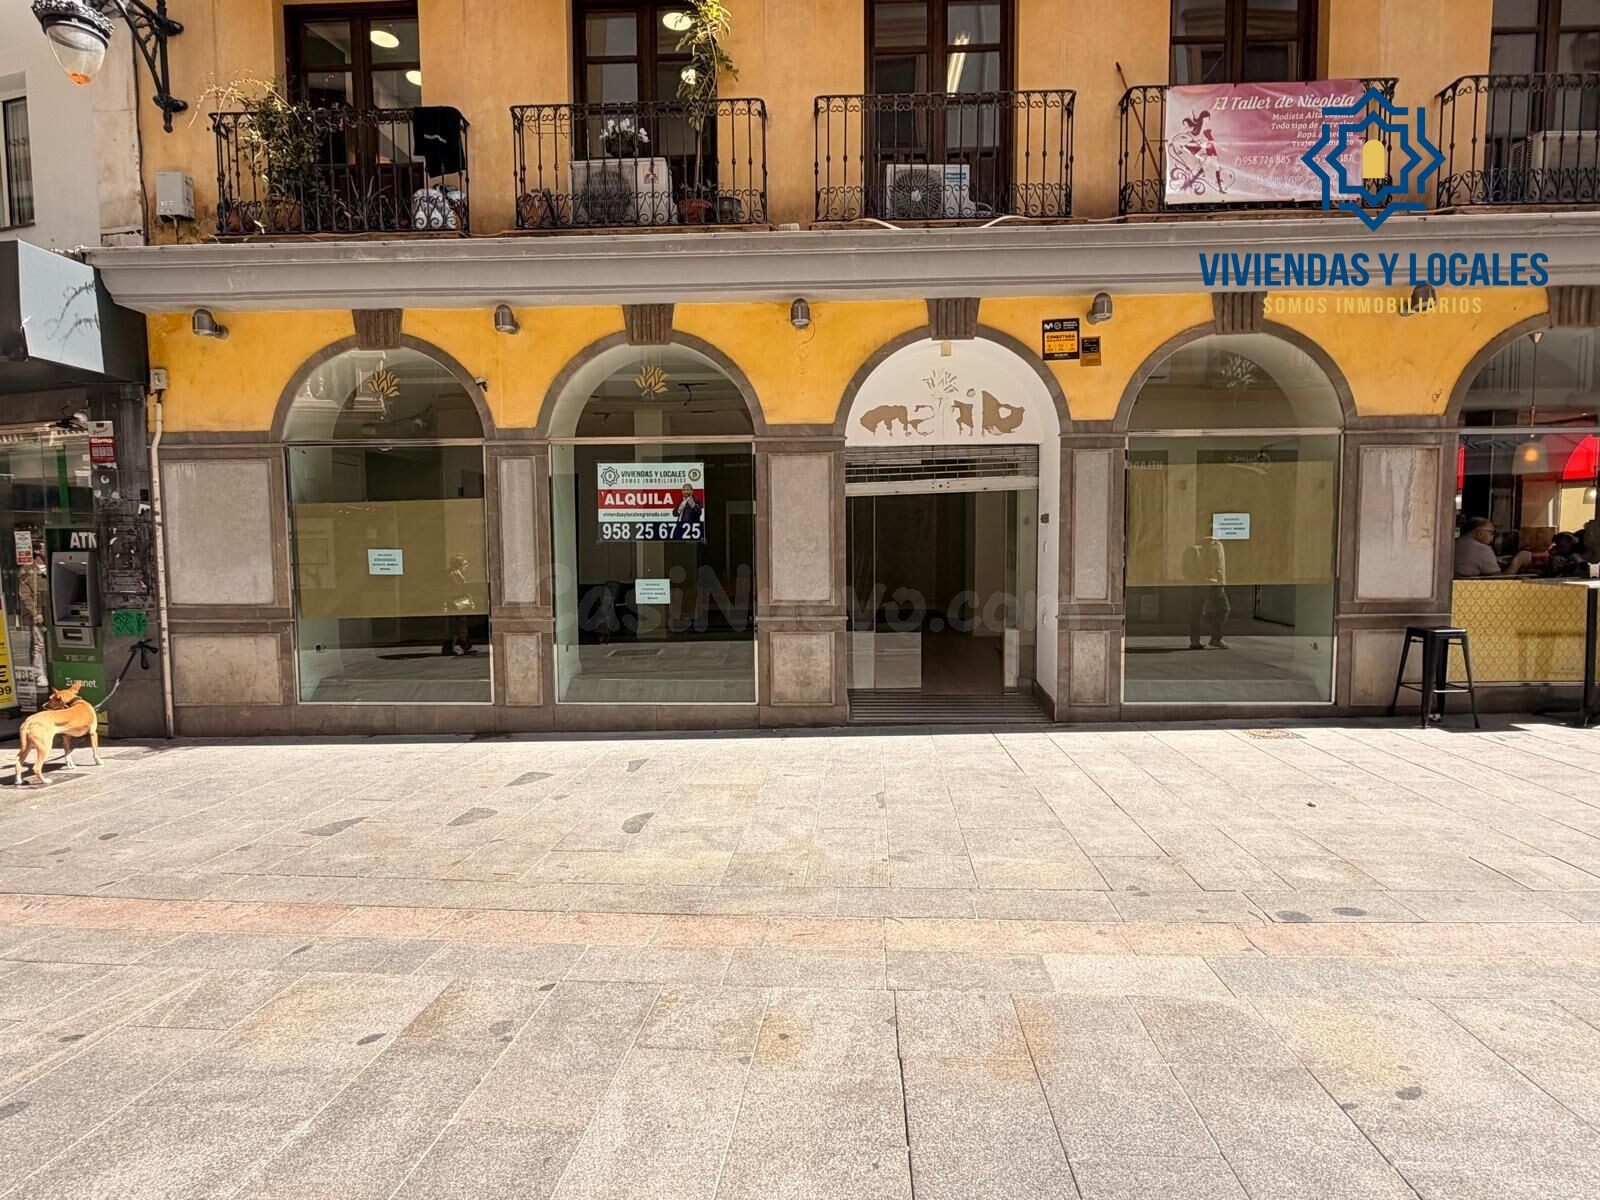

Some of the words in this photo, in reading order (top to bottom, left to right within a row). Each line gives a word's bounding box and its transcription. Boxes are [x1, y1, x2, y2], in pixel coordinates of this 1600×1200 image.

[1213, 97, 1229, 110] El
[1231, 96, 1271, 111] Taller
[1274, 95, 1294, 109] de
[1297, 94, 1356, 108] Nicoleta
[1271, 122, 1291, 130] Todo
[1293, 122, 1307, 131] tipo
[1308, 121, 1319, 129] de
[621, 470, 655, 478] VIVIENDAS
[659, 470, 687, 478] LOCALES
[604, 492, 674, 505] ALQUILA
[602, 522, 631, 540] 958
[635, 522, 654, 540] 25
[658, 522, 677, 540] 67
[681, 522, 701, 540] 25
